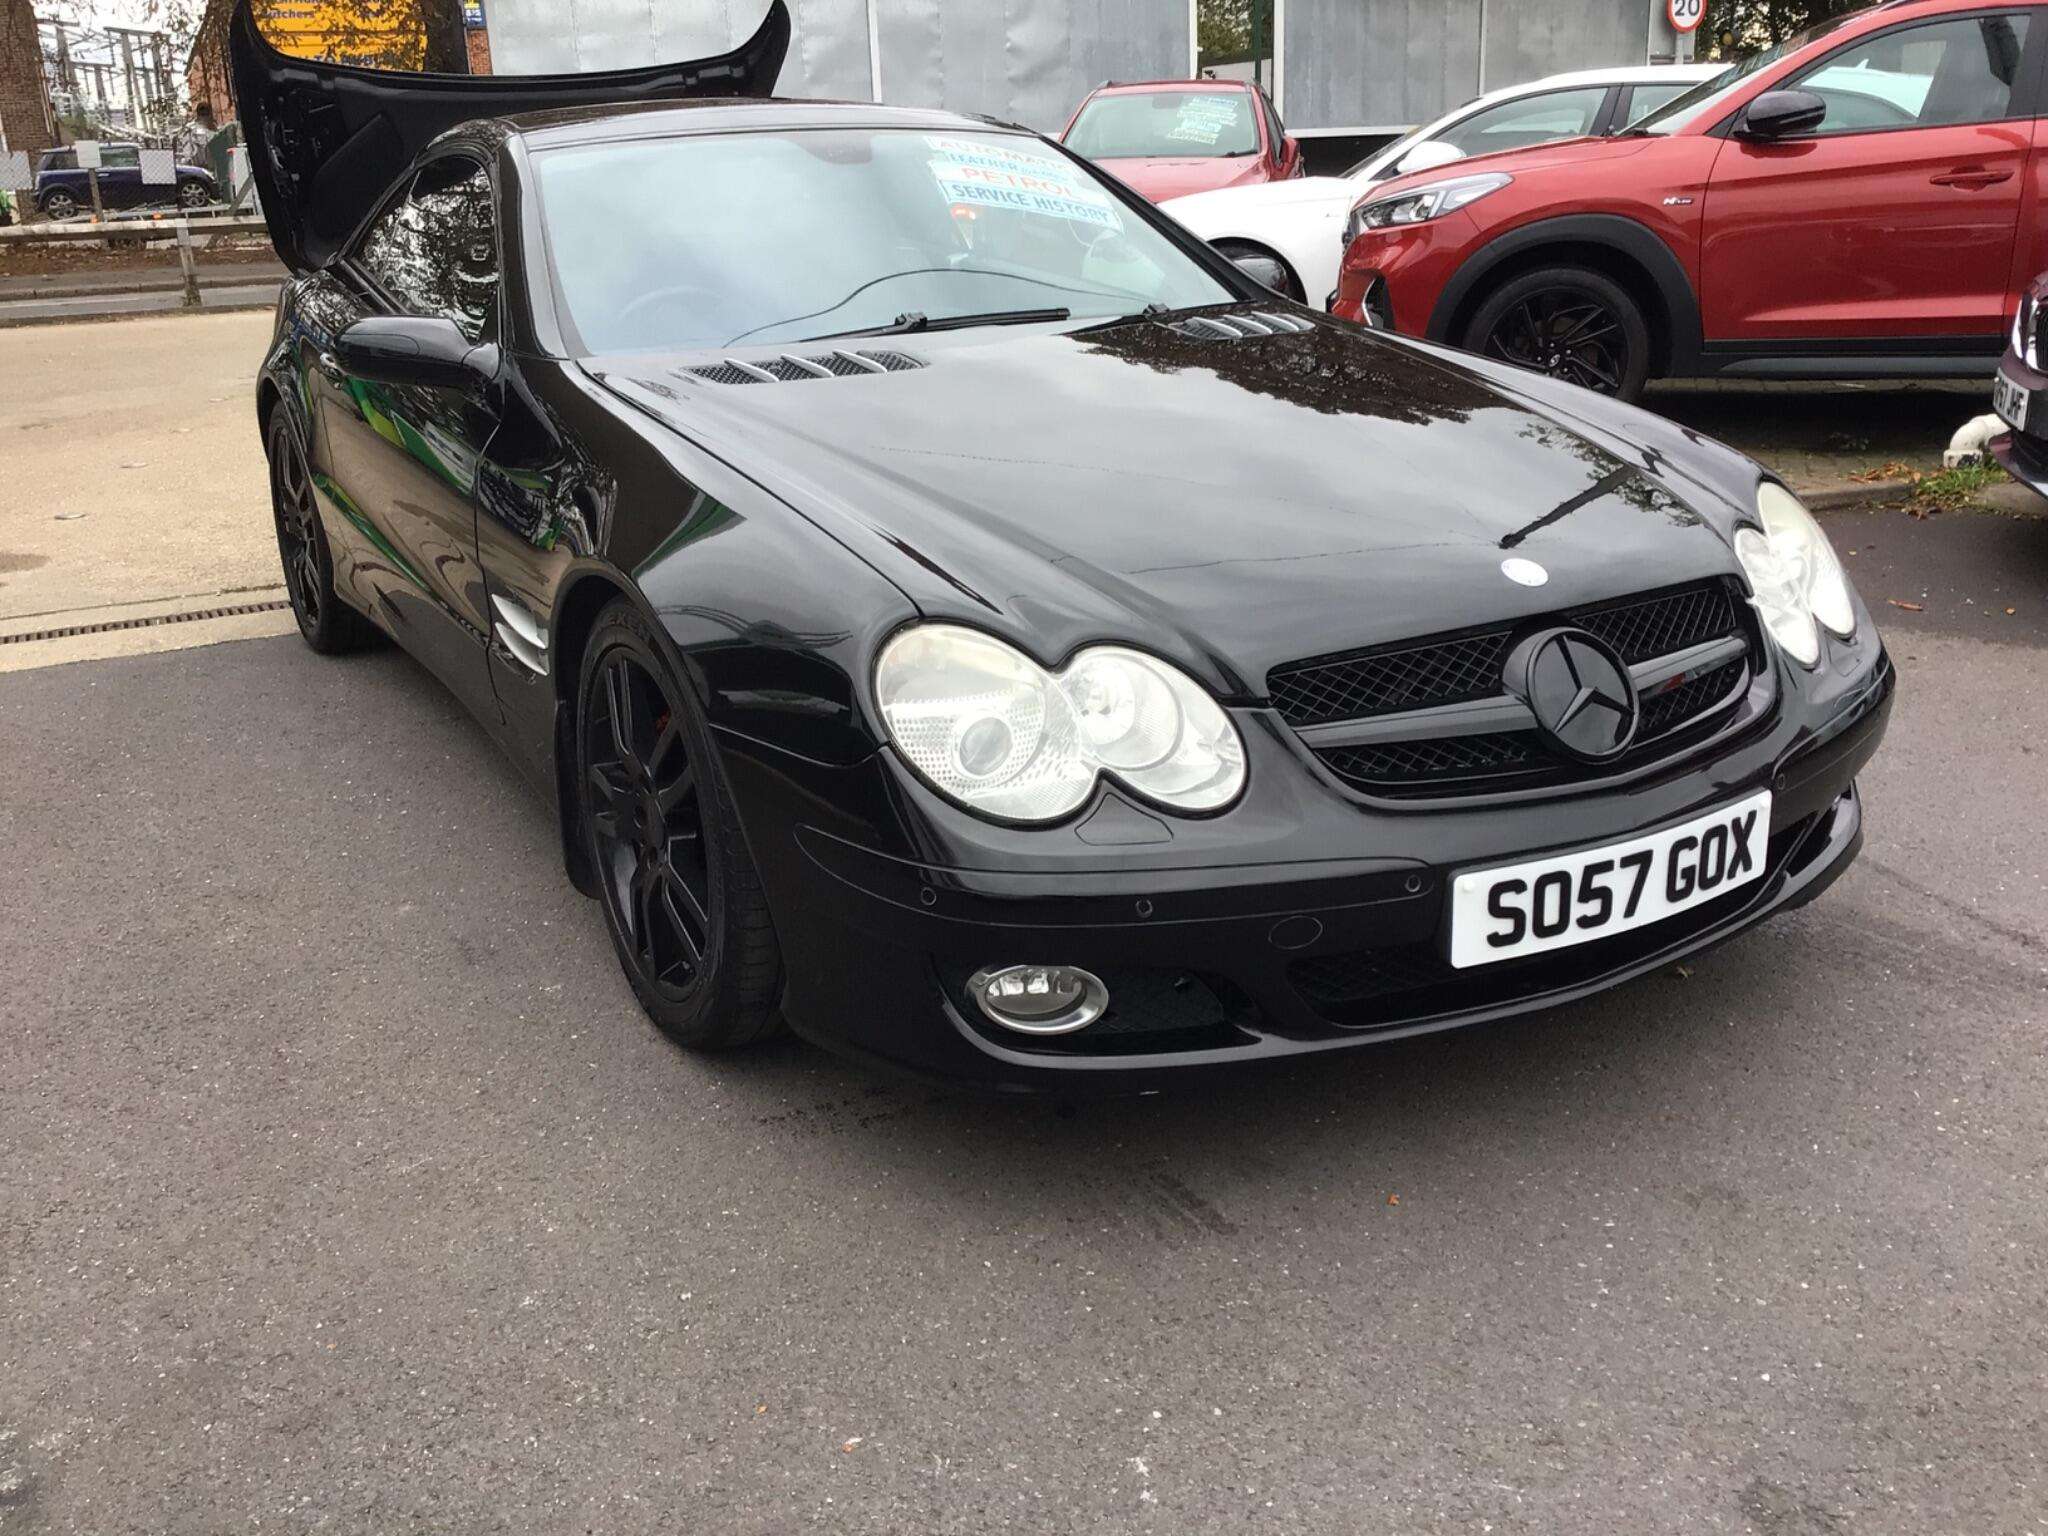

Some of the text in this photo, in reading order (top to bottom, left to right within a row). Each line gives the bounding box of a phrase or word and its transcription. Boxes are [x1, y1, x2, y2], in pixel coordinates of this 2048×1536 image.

[1675, 0, 1699, 16] 20
[961, 167, 1077, 198] PETROL
[952, 185, 1109, 221] SERVICE HISTORY
[1486, 810, 1757, 948] SO57 GOX
